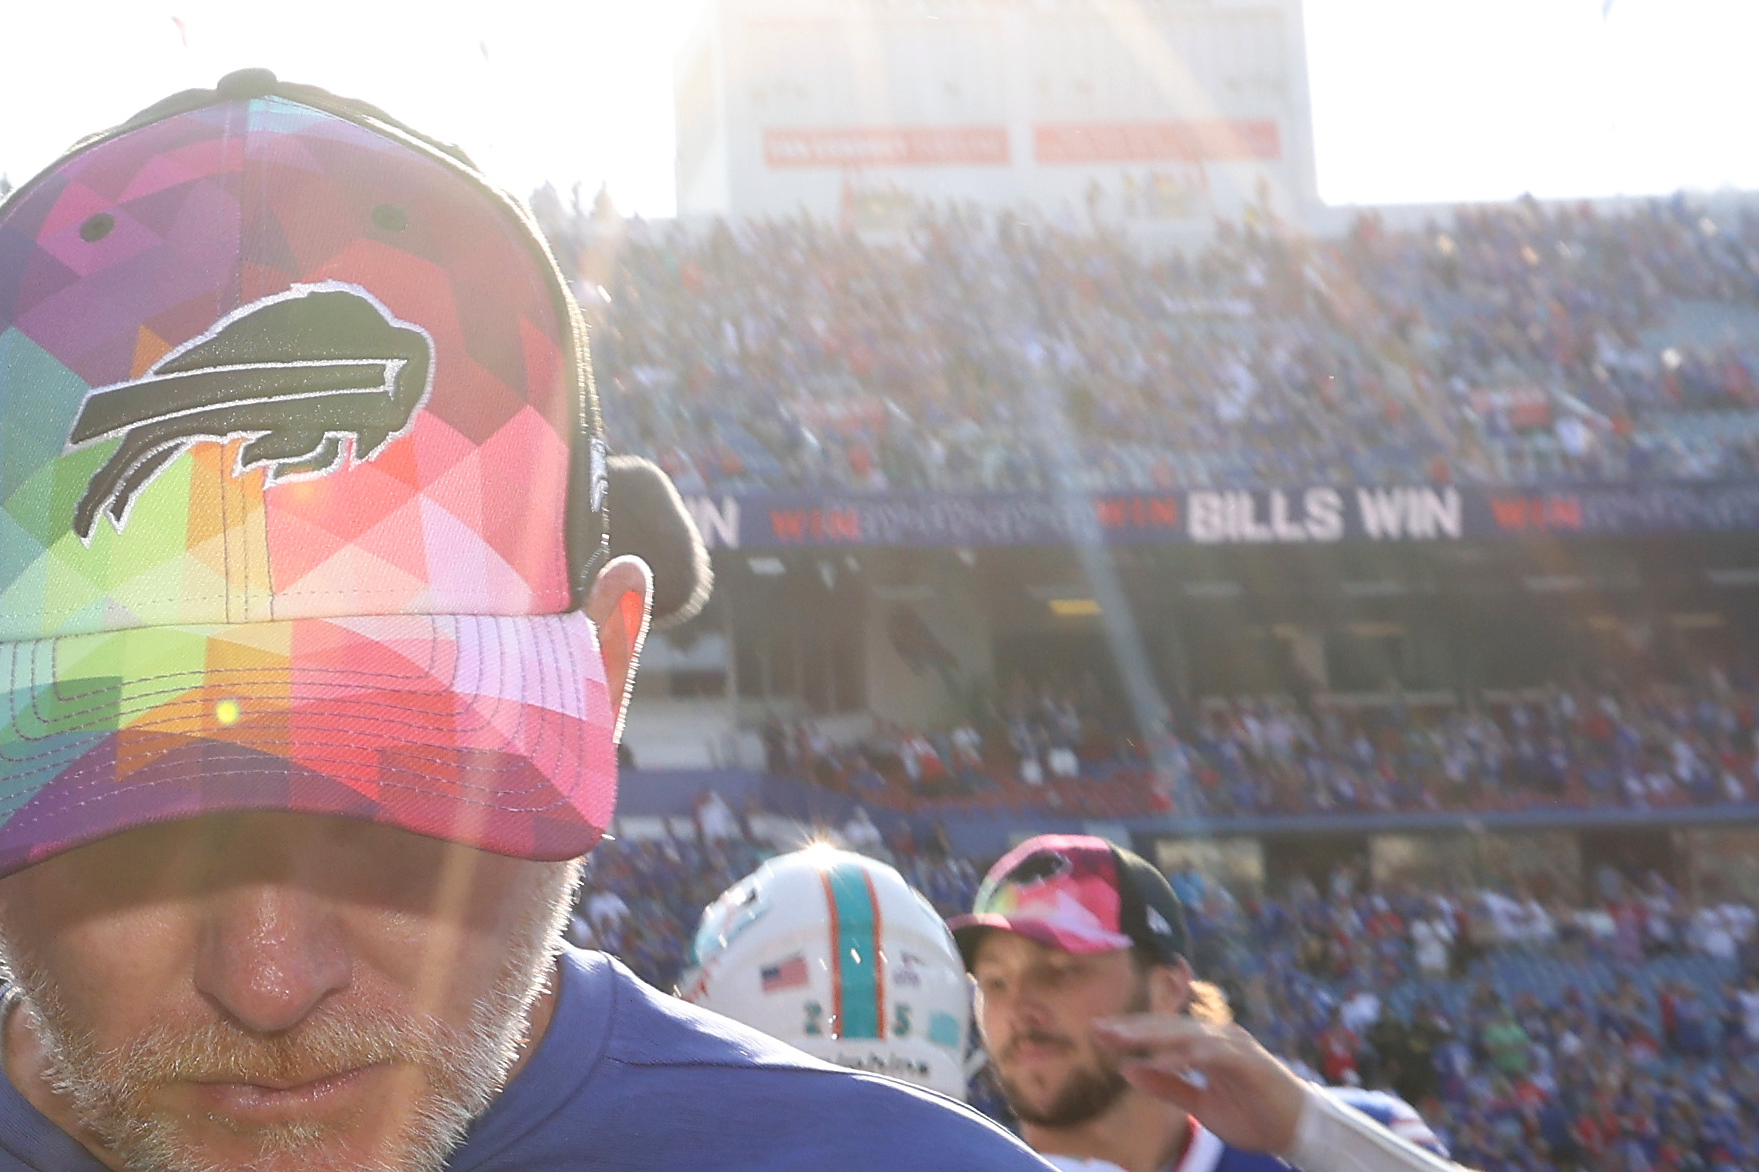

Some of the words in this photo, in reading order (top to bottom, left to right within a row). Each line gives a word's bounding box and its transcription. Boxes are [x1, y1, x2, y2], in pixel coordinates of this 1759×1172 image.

[769, 508, 861, 543] WIN
[1094, 496, 1178, 529] WIN
[1186, 488, 1342, 543] BILLS
[1356, 485, 1462, 542] WIN
